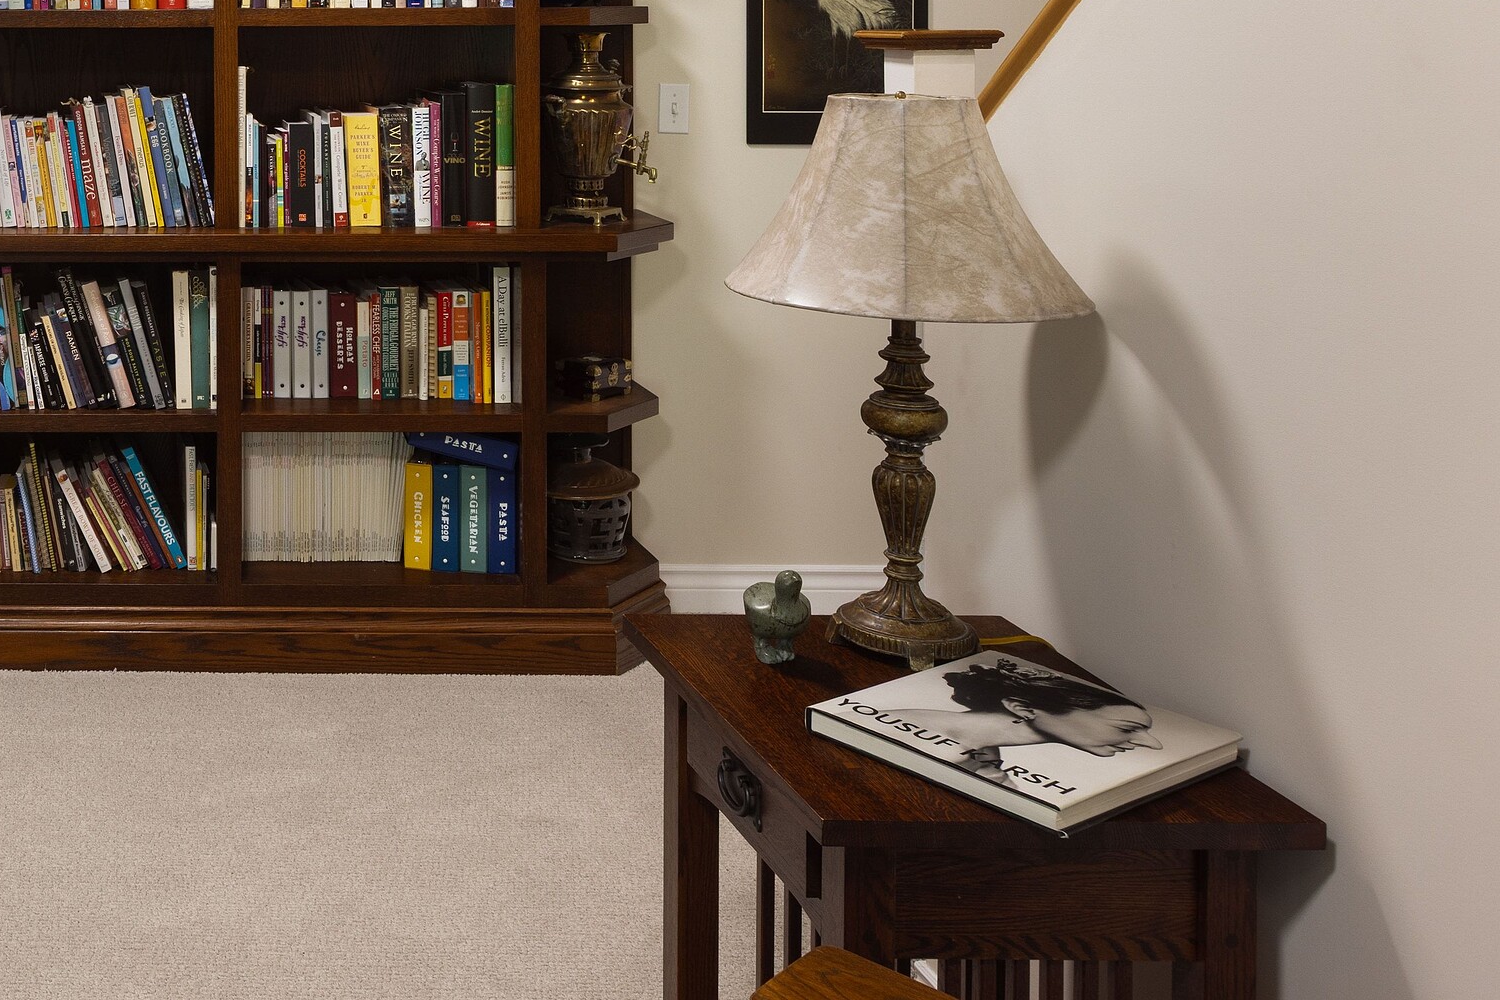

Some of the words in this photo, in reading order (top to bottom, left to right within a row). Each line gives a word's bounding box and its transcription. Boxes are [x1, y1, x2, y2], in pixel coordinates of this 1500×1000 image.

[75, 110, 84, 130] GORDON
[414, 112, 423, 157] JOHNSON
[422, 112, 430, 140] HUGH
[78, 130, 88, 156] RAMSAY'S
[150, 134, 159, 148] EGG
[157, 121, 174, 175] COOKBOOK
[388, 124, 403, 178] WINE
[474, 116, 492, 178] WINE
[299, 148, 307, 188] COCKTAILS
[443, 156, 466, 164] VINO
[80, 158, 97, 202] maze
[421, 172, 430, 205] WINE
[126, 304, 141, 331] TETSUYA
[372, 304, 380, 337] FEARLESS
[64, 330, 80, 361] RAMEN
[151, 339, 167, 378] TASTE
[315, 329, 326, 356] Cheese
[335, 320, 345, 370] DESSERTS
[345, 326, 354, 363] HOLIDAY
[361, 339, 369, 368] Potato
[372, 336, 380, 354] CHEF
[444, 435, 484, 454] PASTA
[107, 475, 129, 510] CHEESE
[135, 470, 155, 495] FAST
[145, 494, 176, 546] FLAVOURS
[56, 498, 68, 530] Scanwiches
[413, 491, 425, 544] CHICKEN
[440, 495, 451, 542] SEAFOOD
[468, 485, 479, 554] VEGETARIAN
[498, 502, 509, 541] PASTA
[837, 697, 961, 748] YOUSUF
[959, 747, 1078, 796] KARSH
